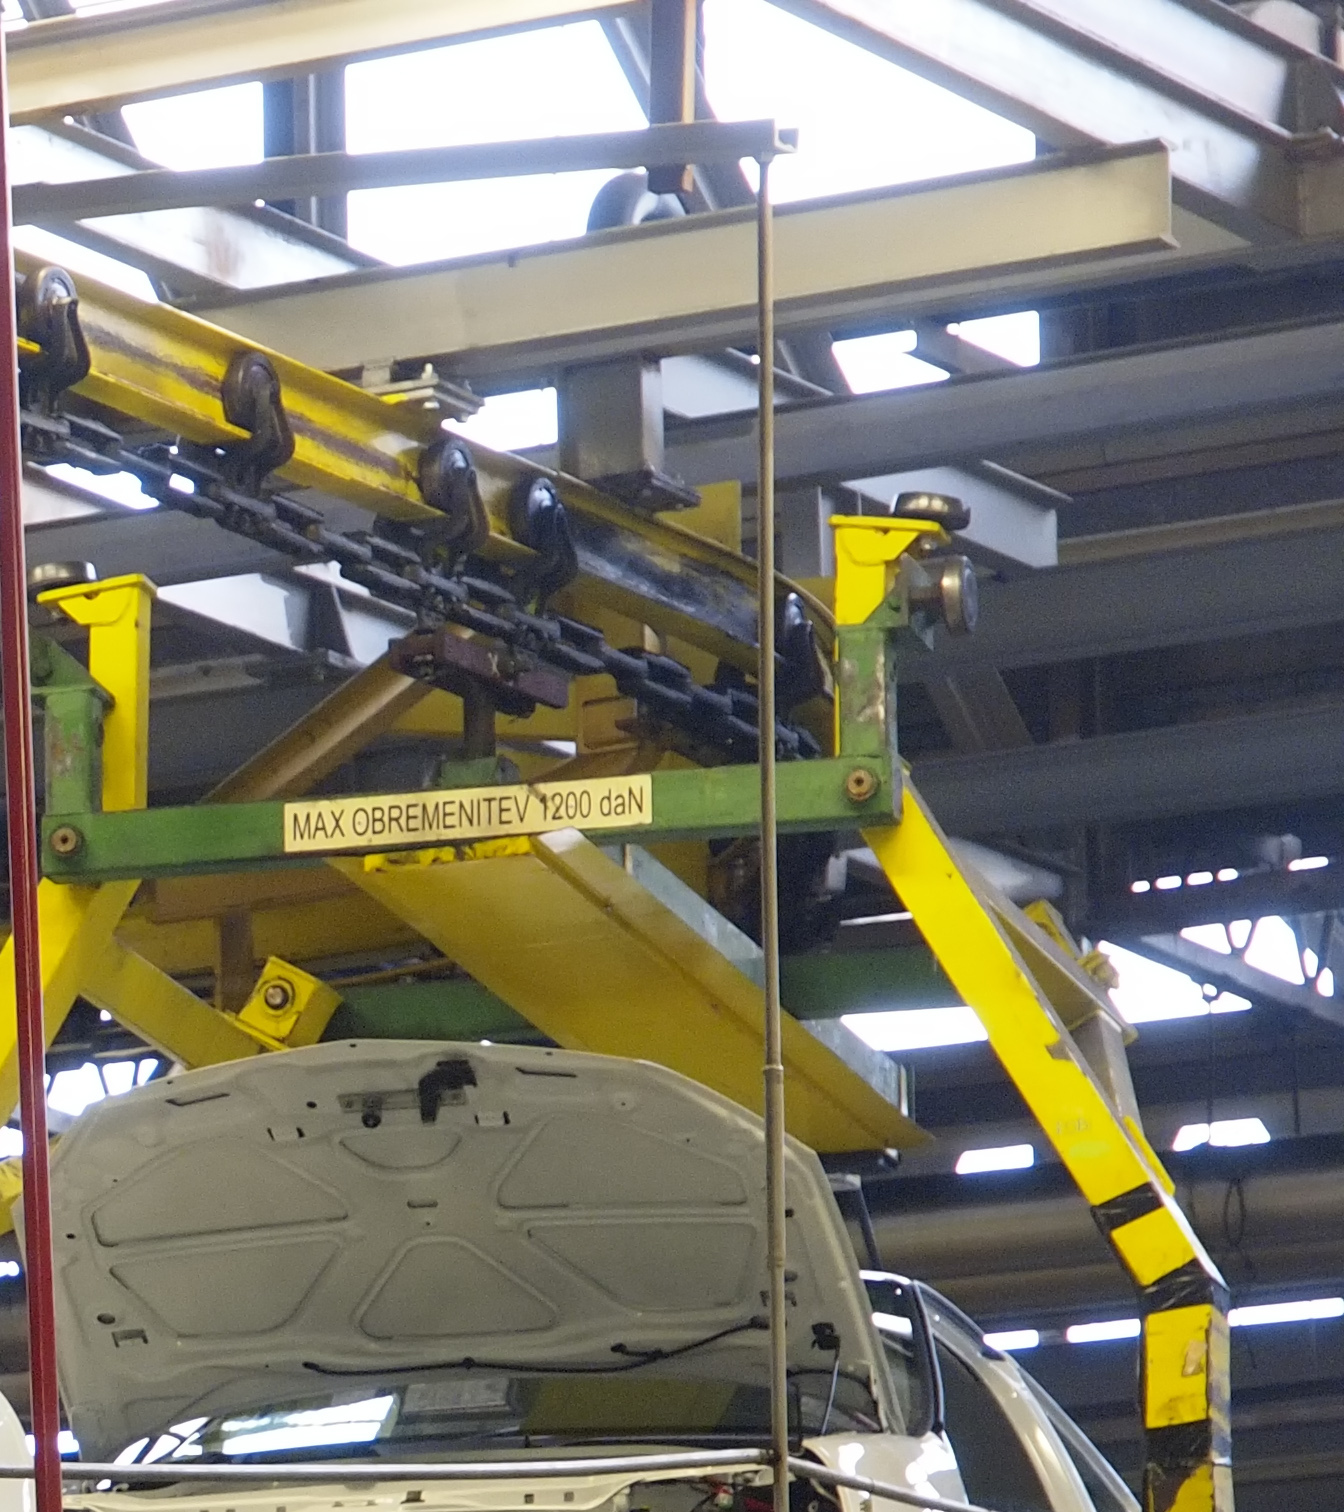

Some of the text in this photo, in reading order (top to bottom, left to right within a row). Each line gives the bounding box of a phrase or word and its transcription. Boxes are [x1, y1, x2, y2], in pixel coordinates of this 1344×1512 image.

[293, 785, 645, 842] MAX OBREMENITEV 1200 daN
